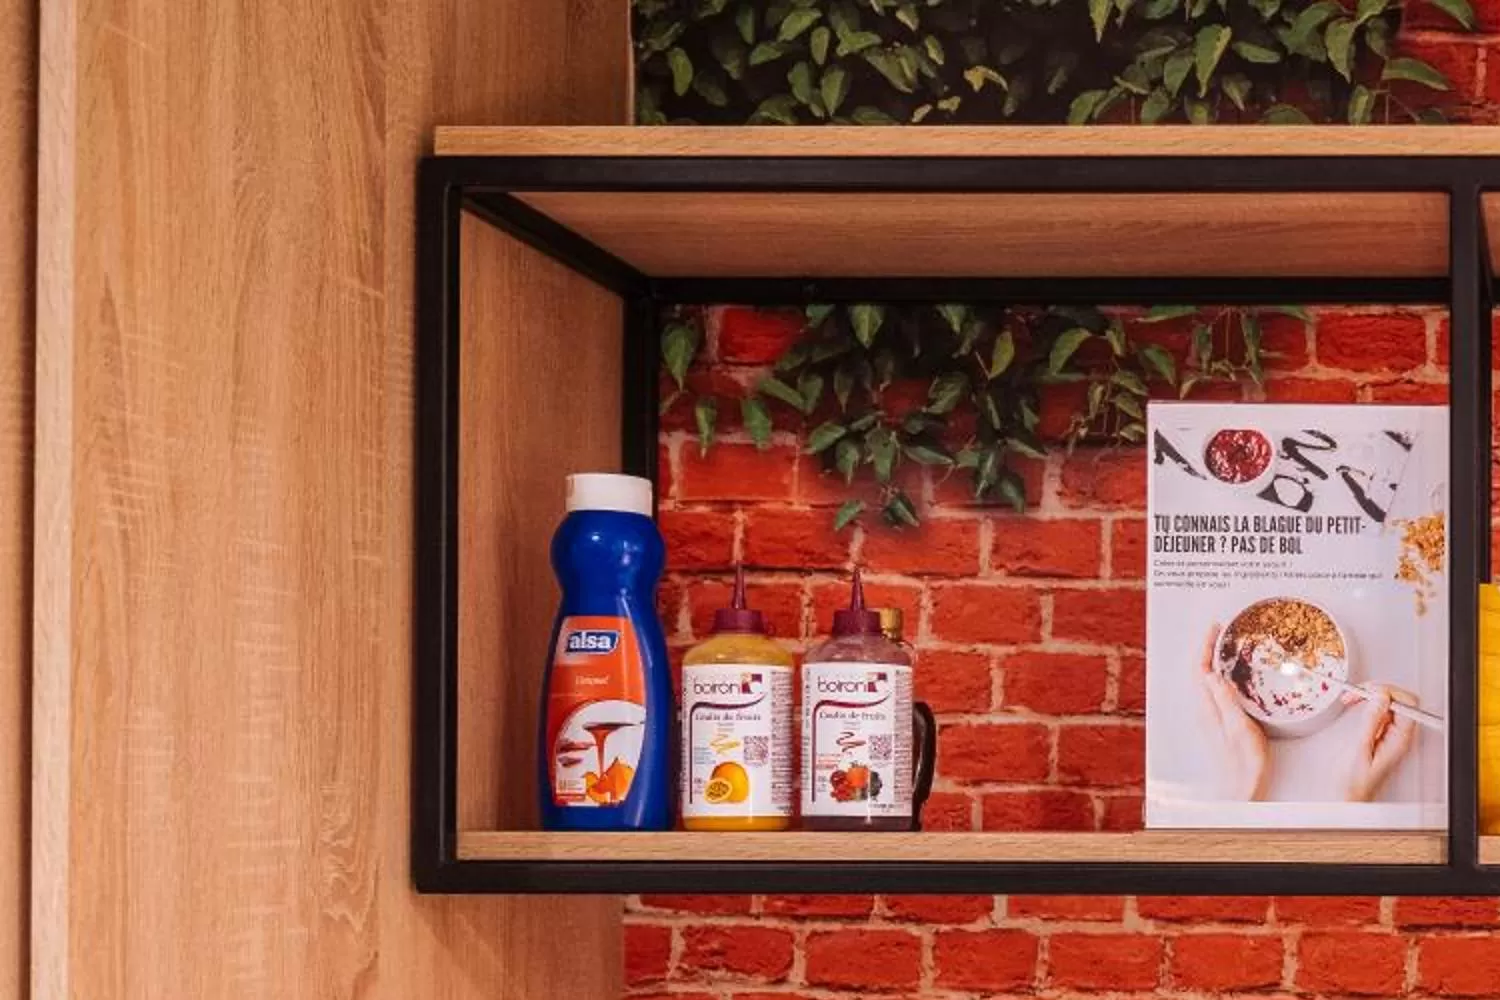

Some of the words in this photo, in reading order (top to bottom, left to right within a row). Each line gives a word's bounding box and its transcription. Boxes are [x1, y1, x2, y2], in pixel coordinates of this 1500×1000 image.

[1153, 514, 1170, 534] TU
[1173, 515, 1230, 534] CONNAIS
[1234, 515, 1250, 534] LA
[1253, 515, 1302, 534] BLAGUE
[1305, 515, 1323, 534] DU
[1327, 515, 1367, 535] PETIT-
[1153, 535, 1215, 554] DEJEUNER
[1220, 535, 1226, 554] ?
[1231, 535, 1257, 554] PAS
[1259, 535, 1275, 554] DE
[1279, 535, 1304, 554] BOL
[569, 631, 612, 649] alsa
[693, 677, 741, 695] boiron
[817, 675, 867, 693] boiron
